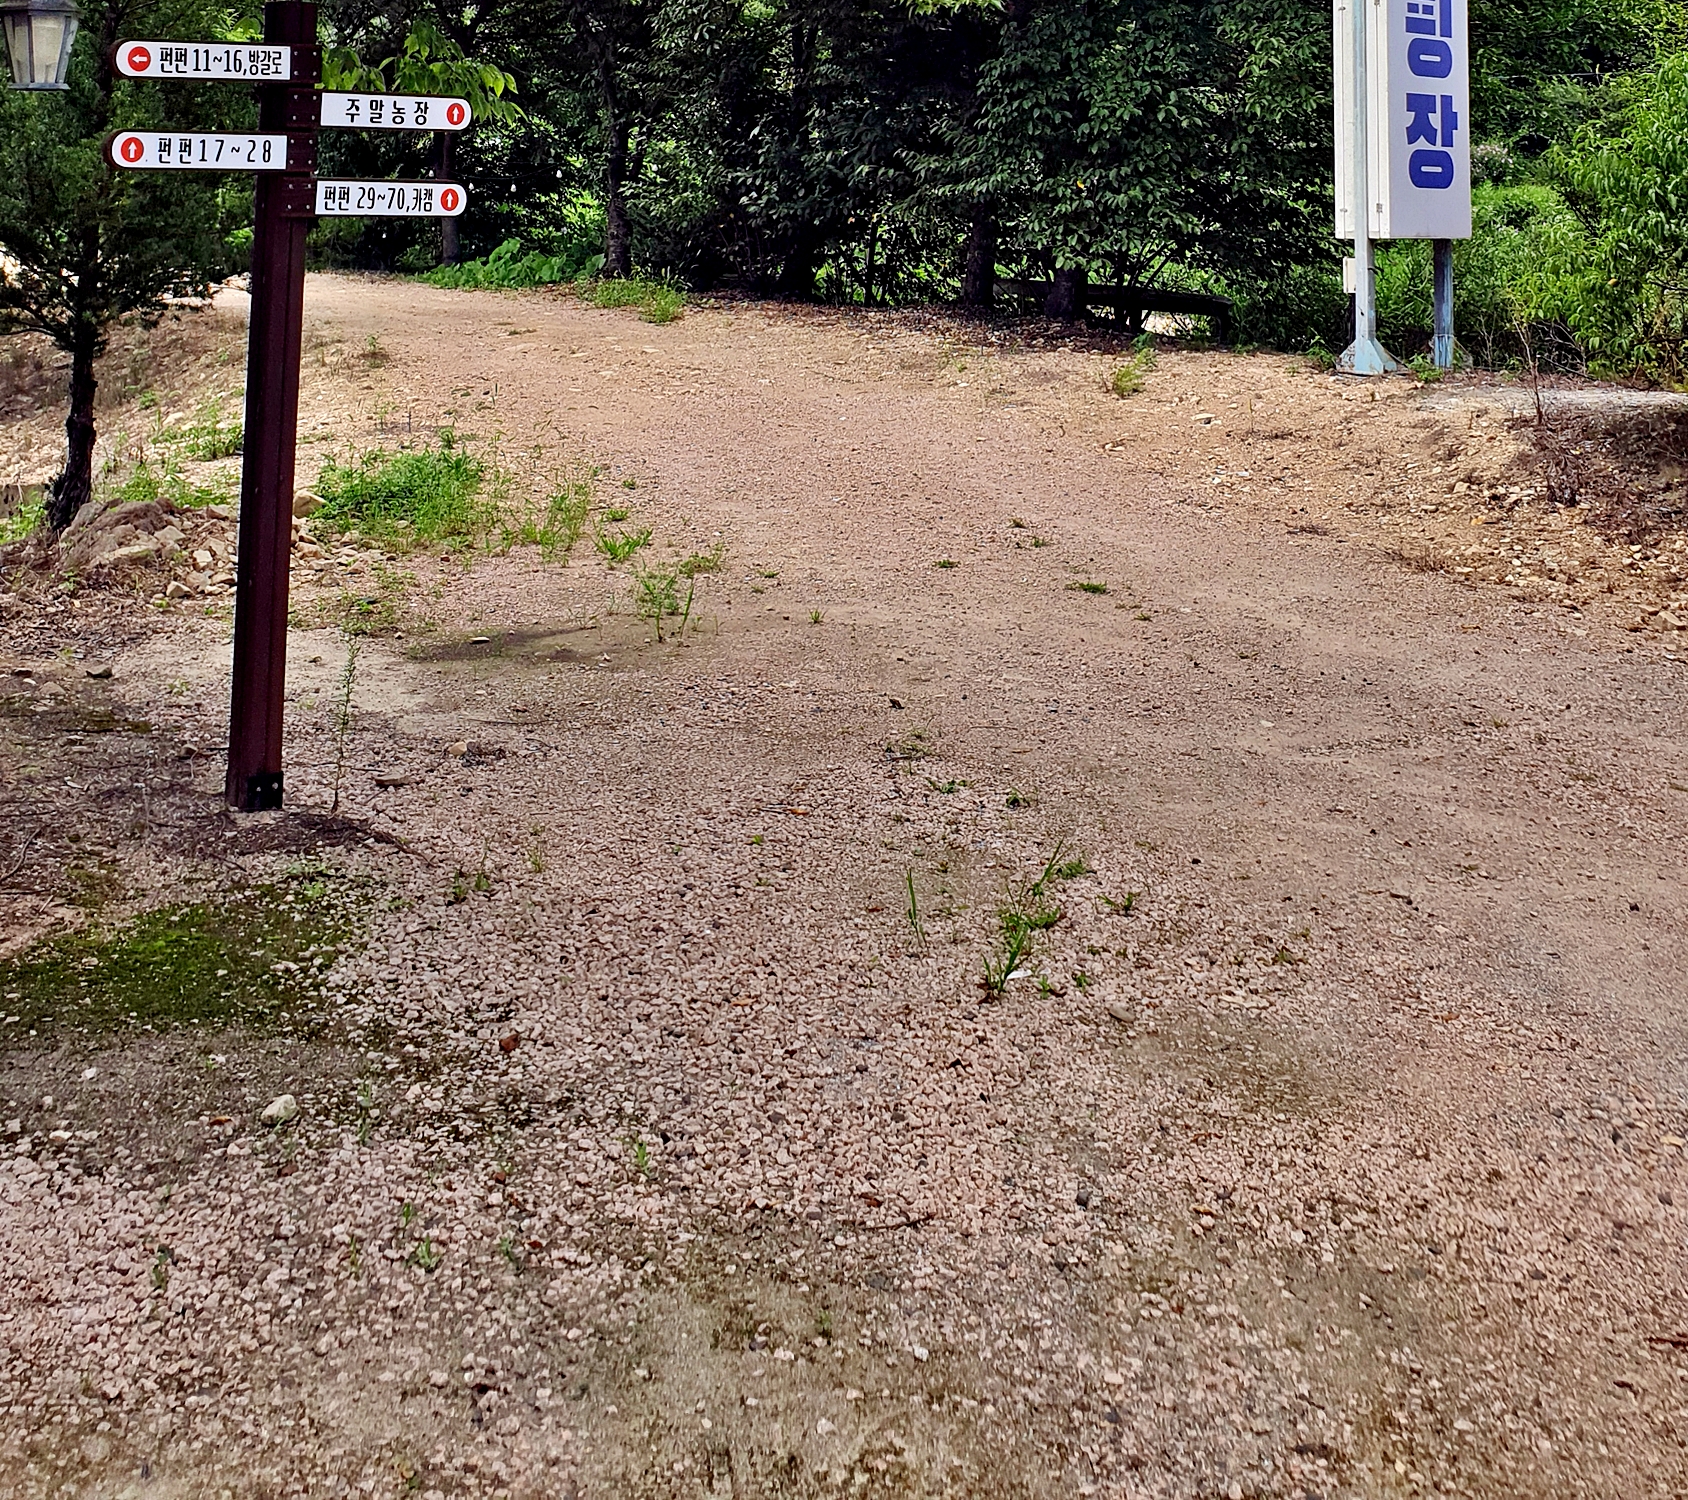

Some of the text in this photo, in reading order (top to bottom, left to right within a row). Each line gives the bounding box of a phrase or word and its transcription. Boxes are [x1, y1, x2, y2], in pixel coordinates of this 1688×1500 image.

[159, 47, 188, 73] 펀펀
[345, 98, 429, 125] 주말농장
[323, 186, 350, 211] 펀펀
